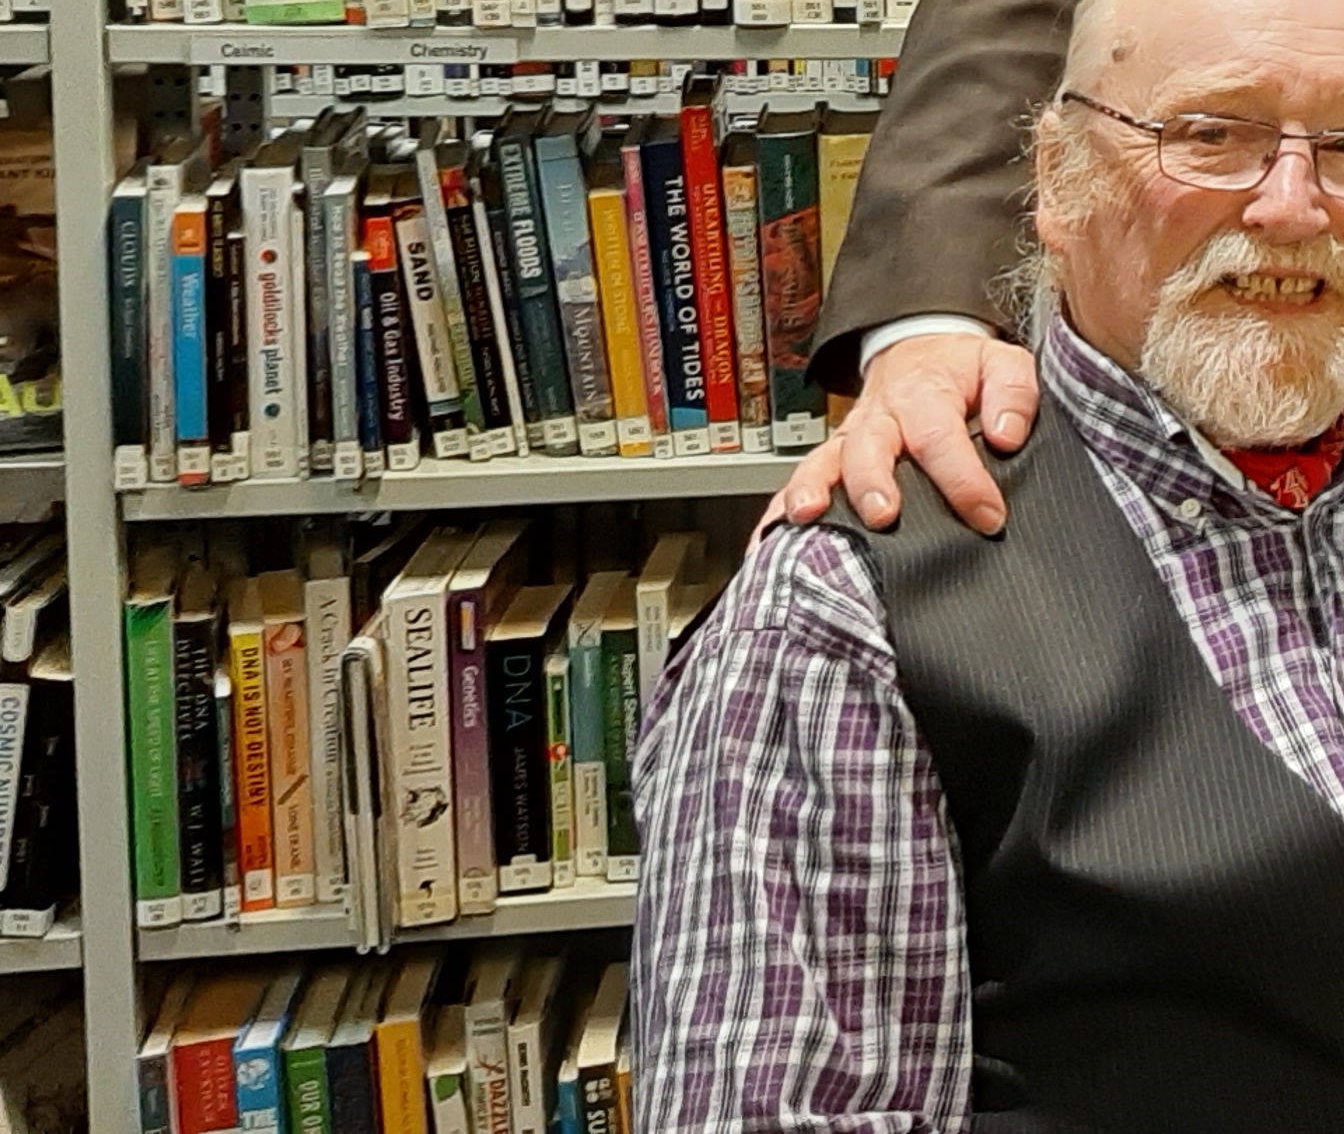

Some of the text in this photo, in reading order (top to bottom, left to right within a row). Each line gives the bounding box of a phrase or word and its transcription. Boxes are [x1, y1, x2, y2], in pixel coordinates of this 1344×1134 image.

[410, 43, 488, 60] Chemistry
[501, 143, 543, 279] EXTREME FLOODS
[181, 273, 200, 340] Weather
[407, 242, 434, 302] SAND
[664, 175, 704, 401] THE WORLD OF TIDES
[258, 272, 283, 395] goldilocks planet
[379, 292, 406, 421] Oil & Gas Industry
[572, 306, 598, 403] MOUNTAIN
[713, 315, 731, 384] DRAGON
[404, 608, 436, 731] SEALIFE
[461, 665, 479, 728] Genetics
[503, 654, 532, 732] DNA
[622, 653, 637, 695] Rupert
[192, 694, 208, 732] DNA
[240, 647, 266, 808] DNA IS NOT DESTINY
[515, 793, 530, 852] WATSON
[299, 1080, 322, 1113] OUR
